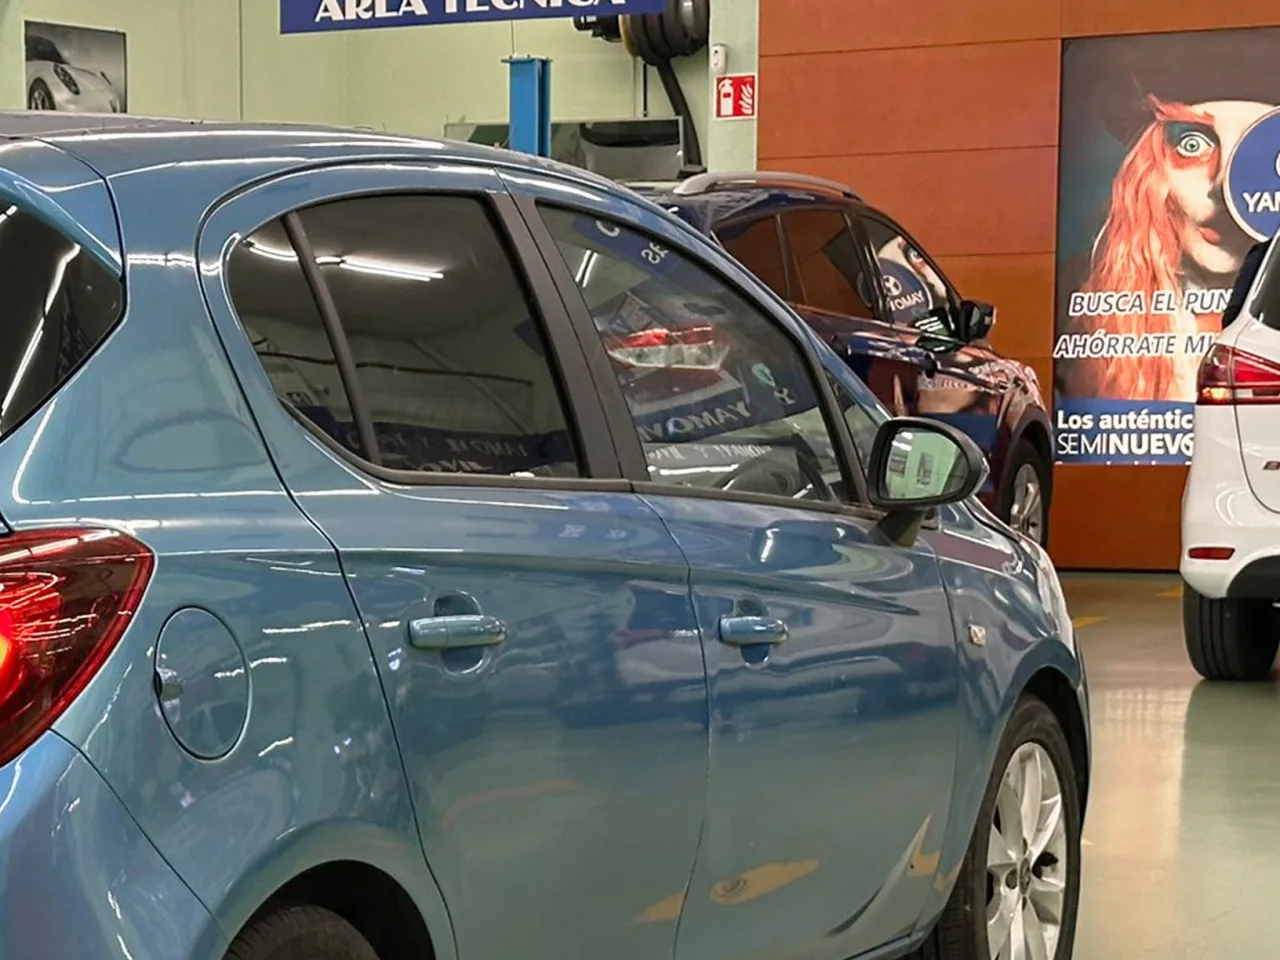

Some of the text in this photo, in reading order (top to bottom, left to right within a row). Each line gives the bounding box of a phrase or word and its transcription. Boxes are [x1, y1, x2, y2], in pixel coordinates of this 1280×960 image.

[1070, 289, 1232, 315] BUSCA EL PUN
[1054, 330, 1177, 357] AHÓRRATE
[1057, 411, 1093, 429] Los
